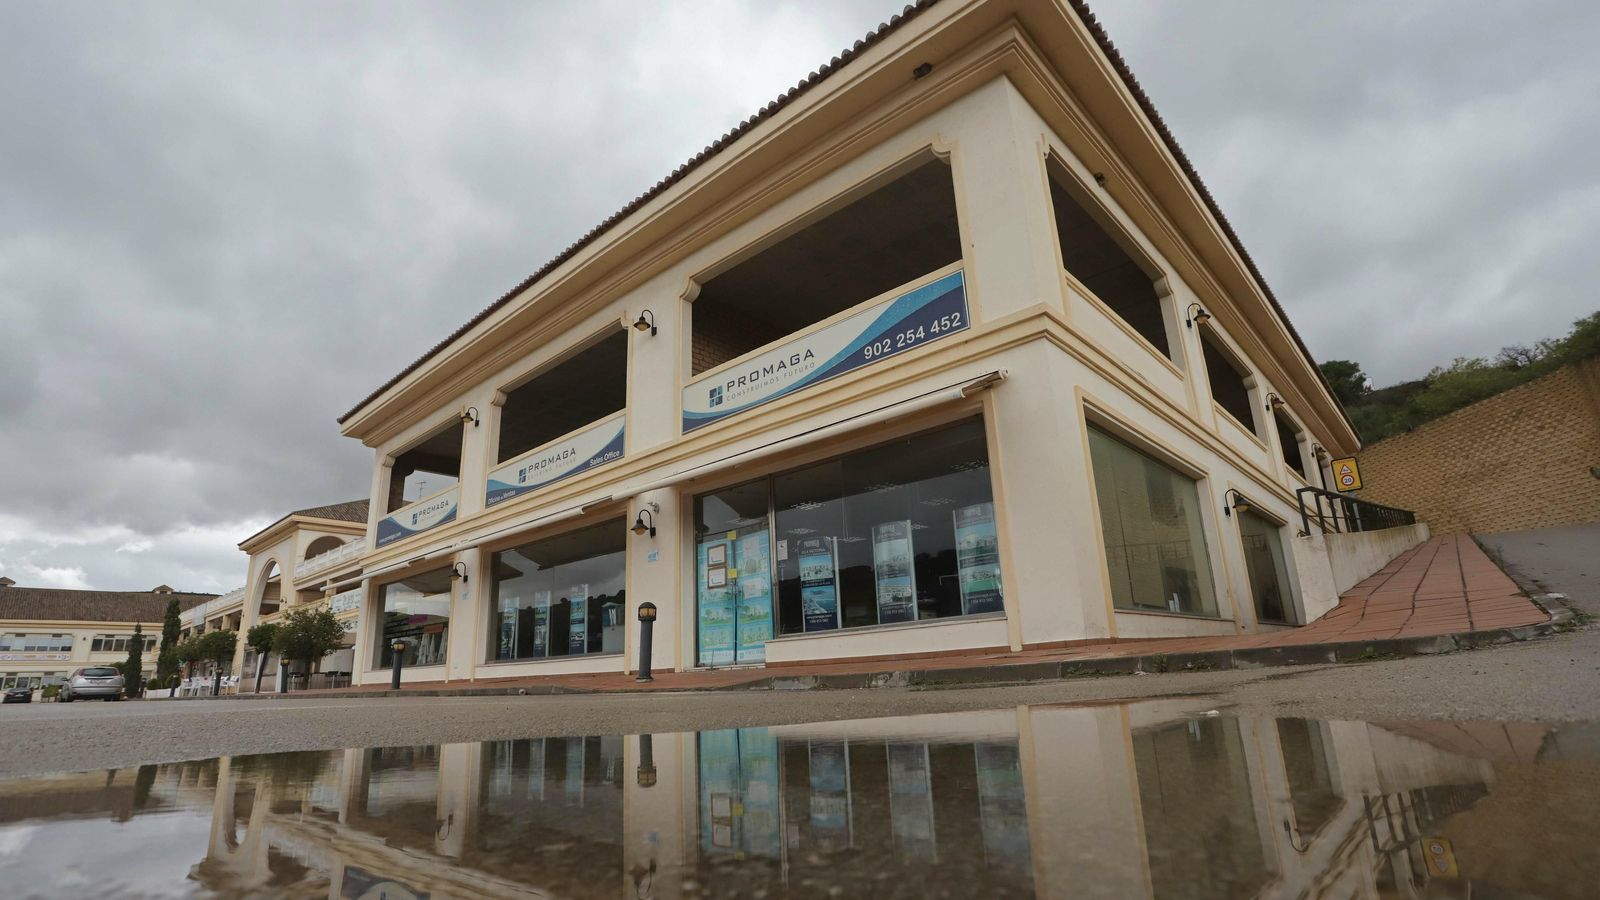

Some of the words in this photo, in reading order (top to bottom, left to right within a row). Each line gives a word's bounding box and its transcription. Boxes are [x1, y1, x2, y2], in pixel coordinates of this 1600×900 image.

[864, 340, 892, 360] 902
[896, 325, 926, 349] 254
[930, 312, 962, 335] 452
[726, 348, 815, 393] PROMAGA
[726, 376, 781, 402] CONSTRUIMOS
[783, 361, 816, 380] FUTURO
[528, 447, 577, 473] PROMAGA
[589, 454, 604, 467] Sales
[604, 449, 620, 461] Office
[418, 499, 449, 517] PROMAGA
